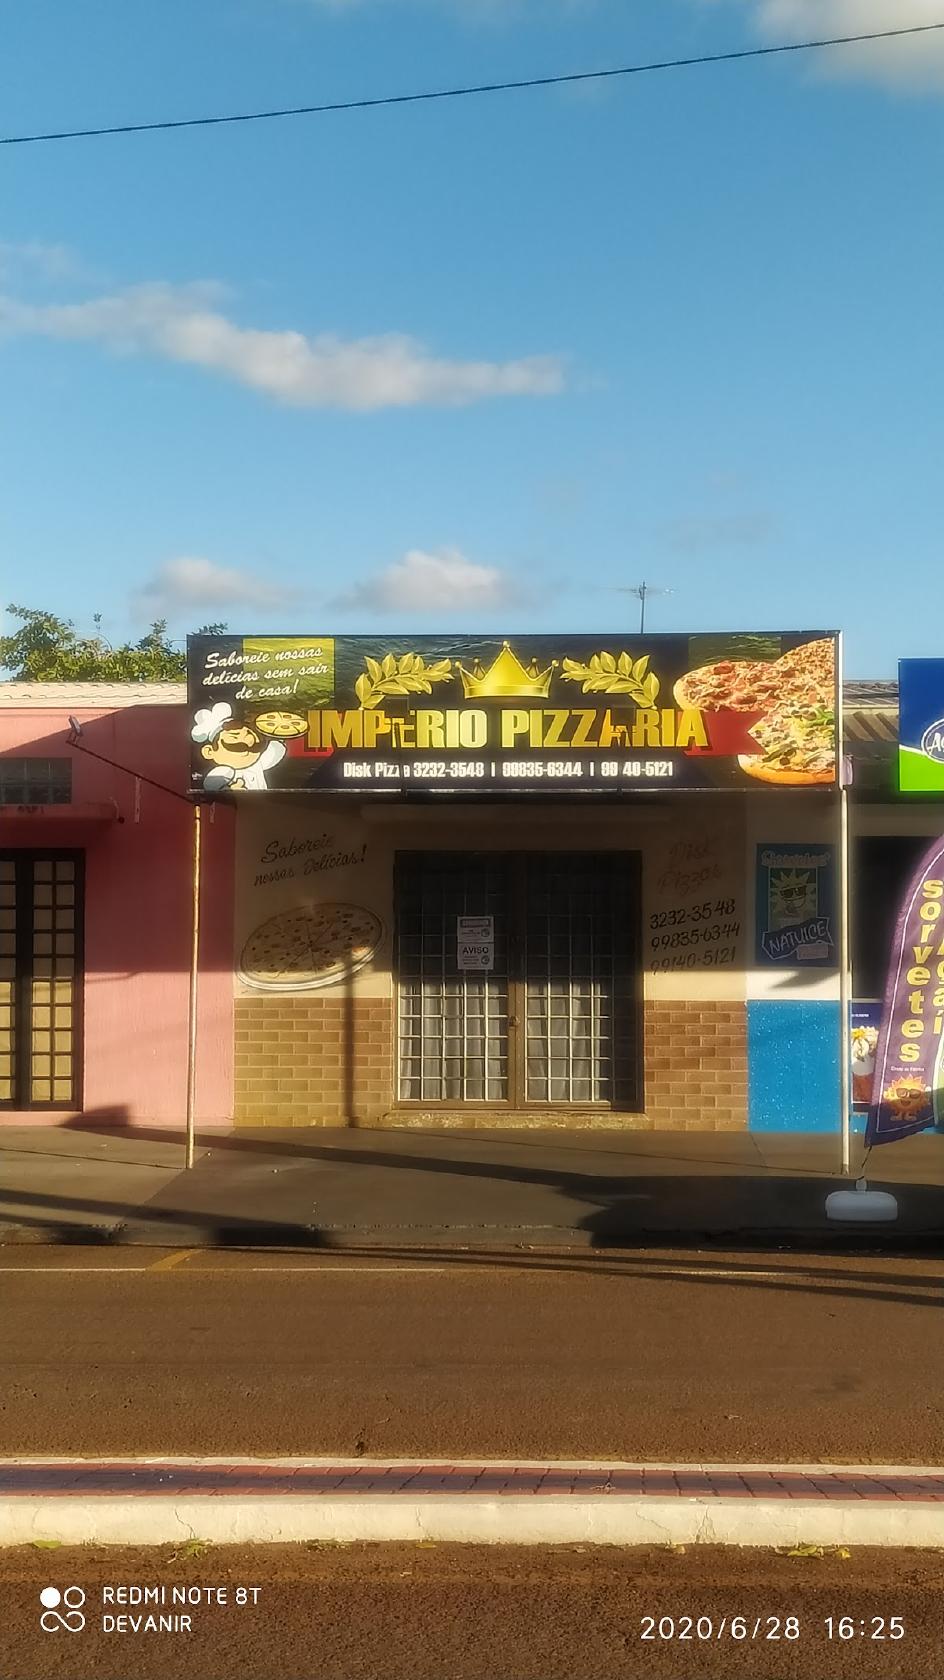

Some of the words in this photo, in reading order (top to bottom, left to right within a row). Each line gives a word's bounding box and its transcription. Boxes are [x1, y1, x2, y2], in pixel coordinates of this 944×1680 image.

[205, 651, 270, 669] Saboreie
[275, 647, 323, 661] nossas
[264, 668, 294, 679] sem
[298, 663, 328, 675] sair
[235, 686, 253, 700] de
[259, 679, 299, 697] casa!
[343, 762, 371, 778] Disk
[413, 762, 484, 778] 3232-3548
[502, 761, 583, 778] 99835-6344
[650, 899, 736, 929] 3232-3548
[651, 921, 740, 952] 99835-6344
[650, 946, 736, 975] 99140-5121
[899, 879, 944, 1062] sorvetes
